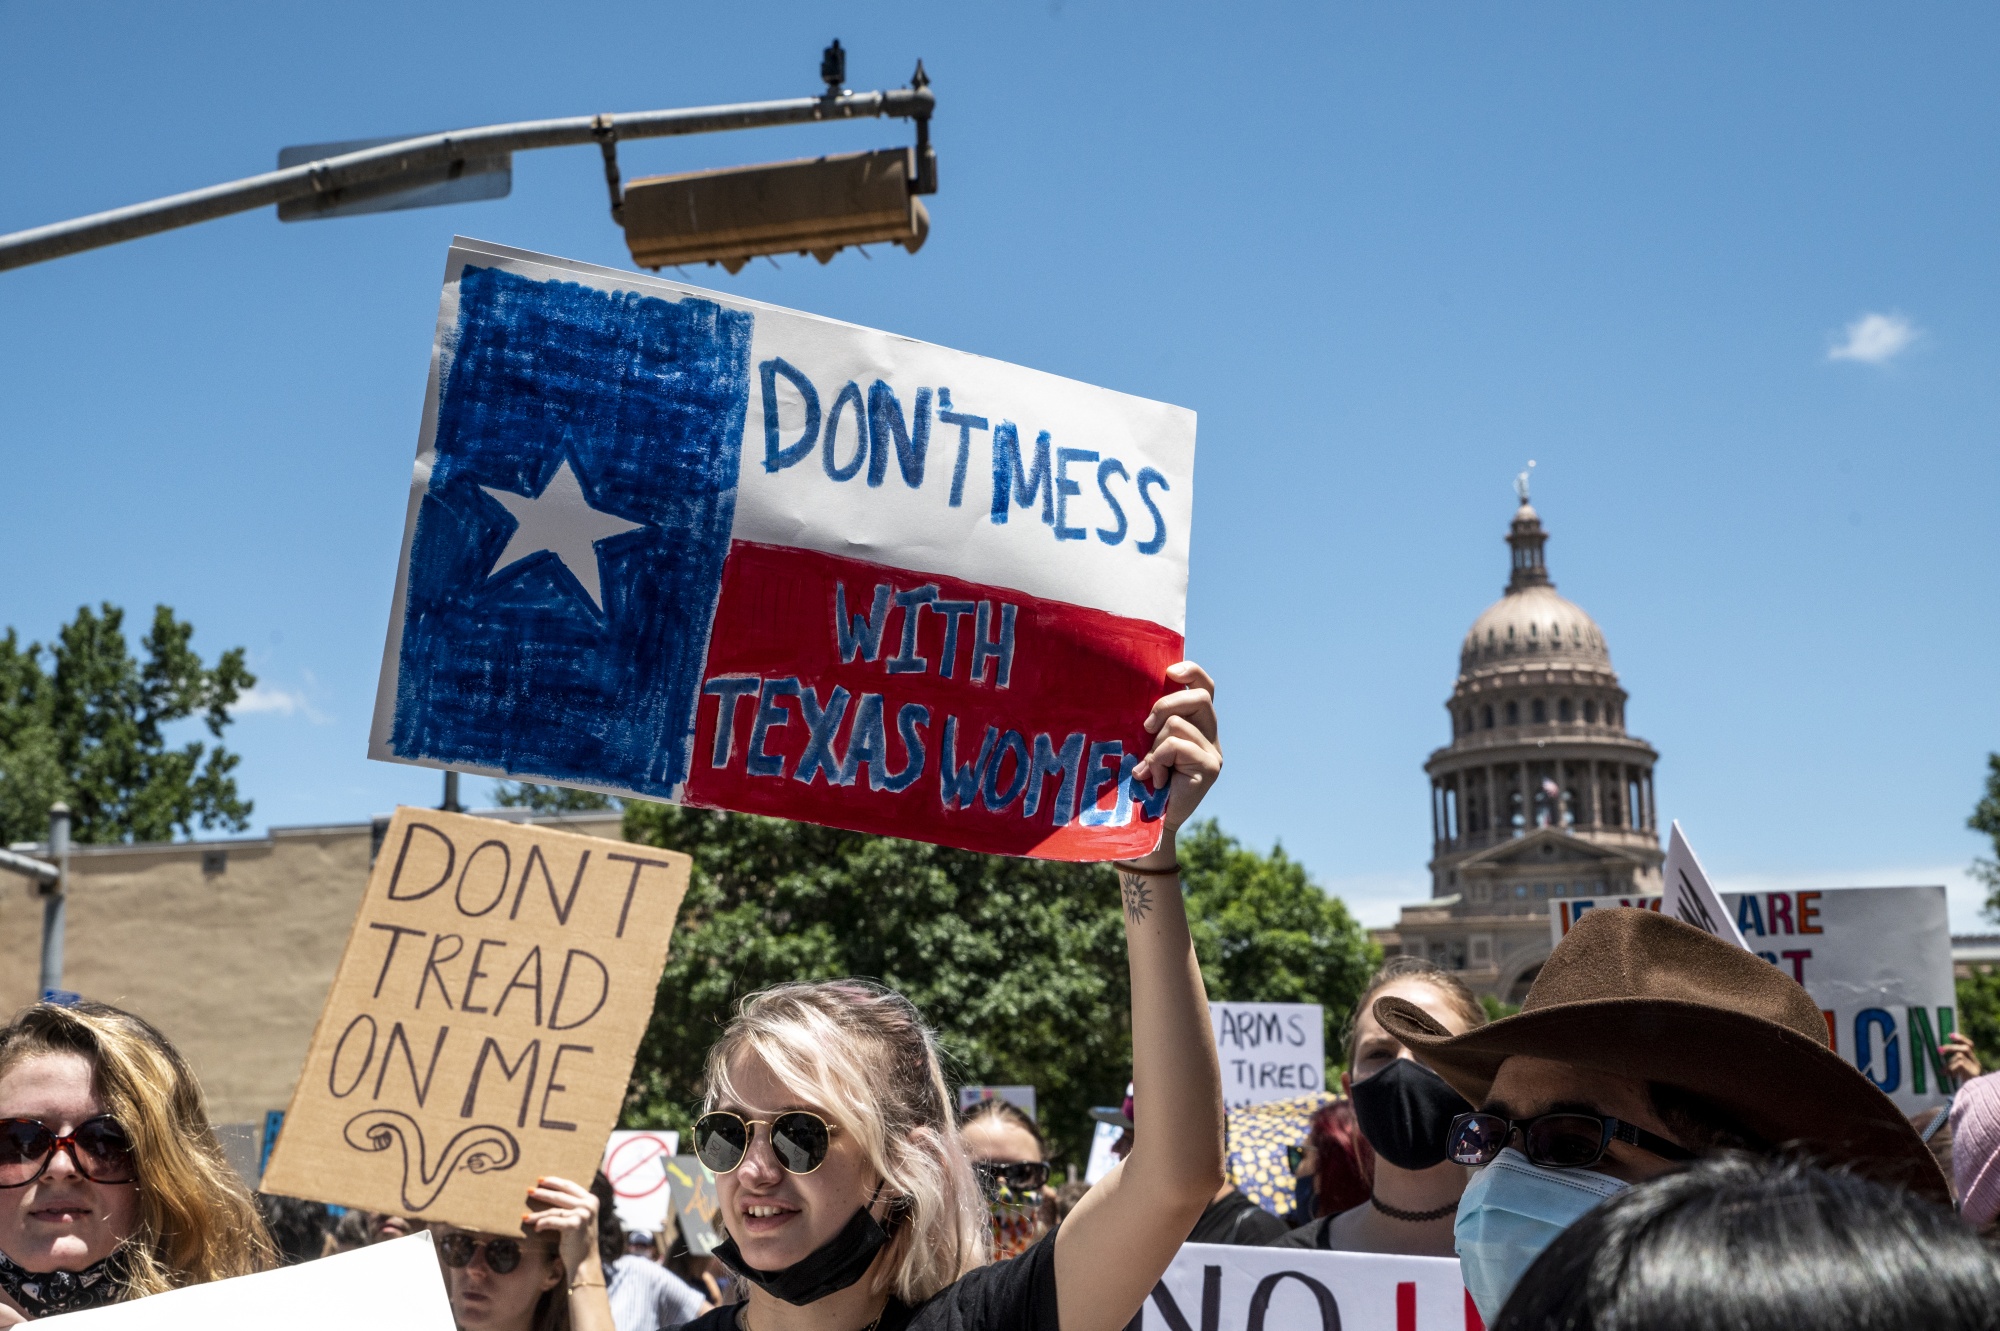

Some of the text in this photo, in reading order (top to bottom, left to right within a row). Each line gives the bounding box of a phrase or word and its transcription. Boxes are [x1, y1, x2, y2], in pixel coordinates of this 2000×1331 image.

[759, 356, 1171, 555] DON'T MESS
[836, 580, 1018, 690] WITH
[703, 676, 931, 793] TEXAS
[388, 823, 670, 938] DONT
[1738, 891, 1824, 936] ARE
[369, 922, 609, 1031] TREAD
[1219, 1007, 1306, 1050] ARMS
[329, 1013, 594, 1131] ON ME
[1230, 1058, 1320, 1091] TIRED
